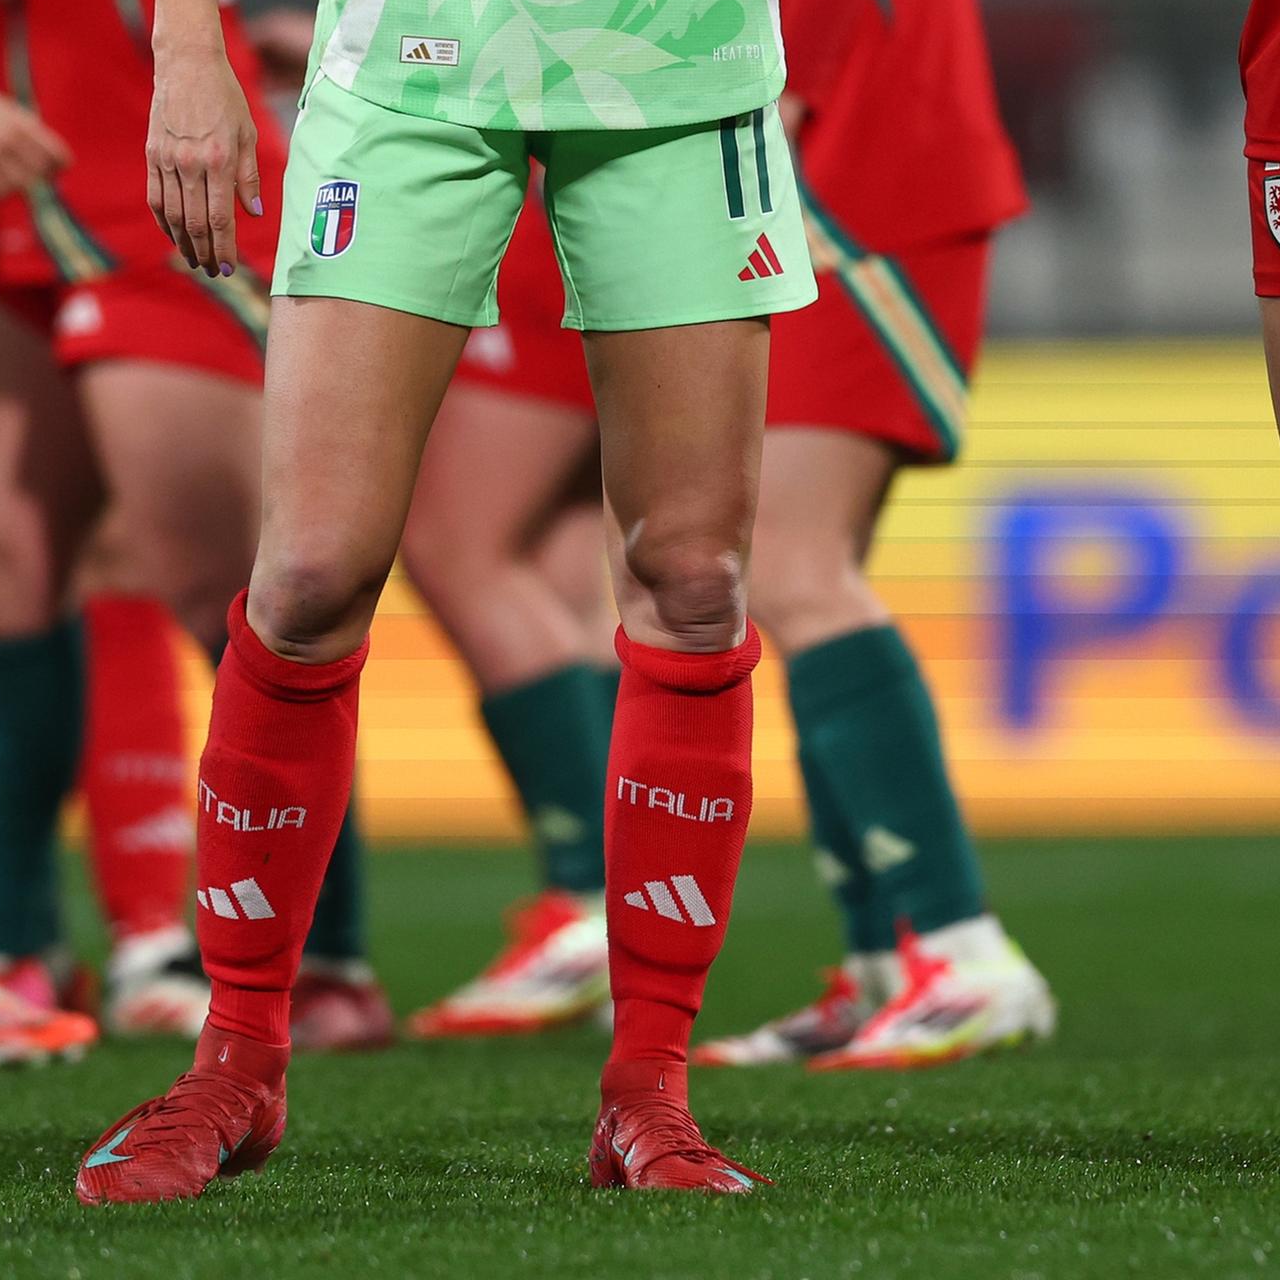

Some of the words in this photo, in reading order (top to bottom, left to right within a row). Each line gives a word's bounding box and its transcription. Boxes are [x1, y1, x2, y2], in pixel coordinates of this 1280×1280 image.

[317, 186, 355, 203] ITALIA
[199, 778, 307, 832] ITALIA
[617, 775, 735, 823] ITALIA
